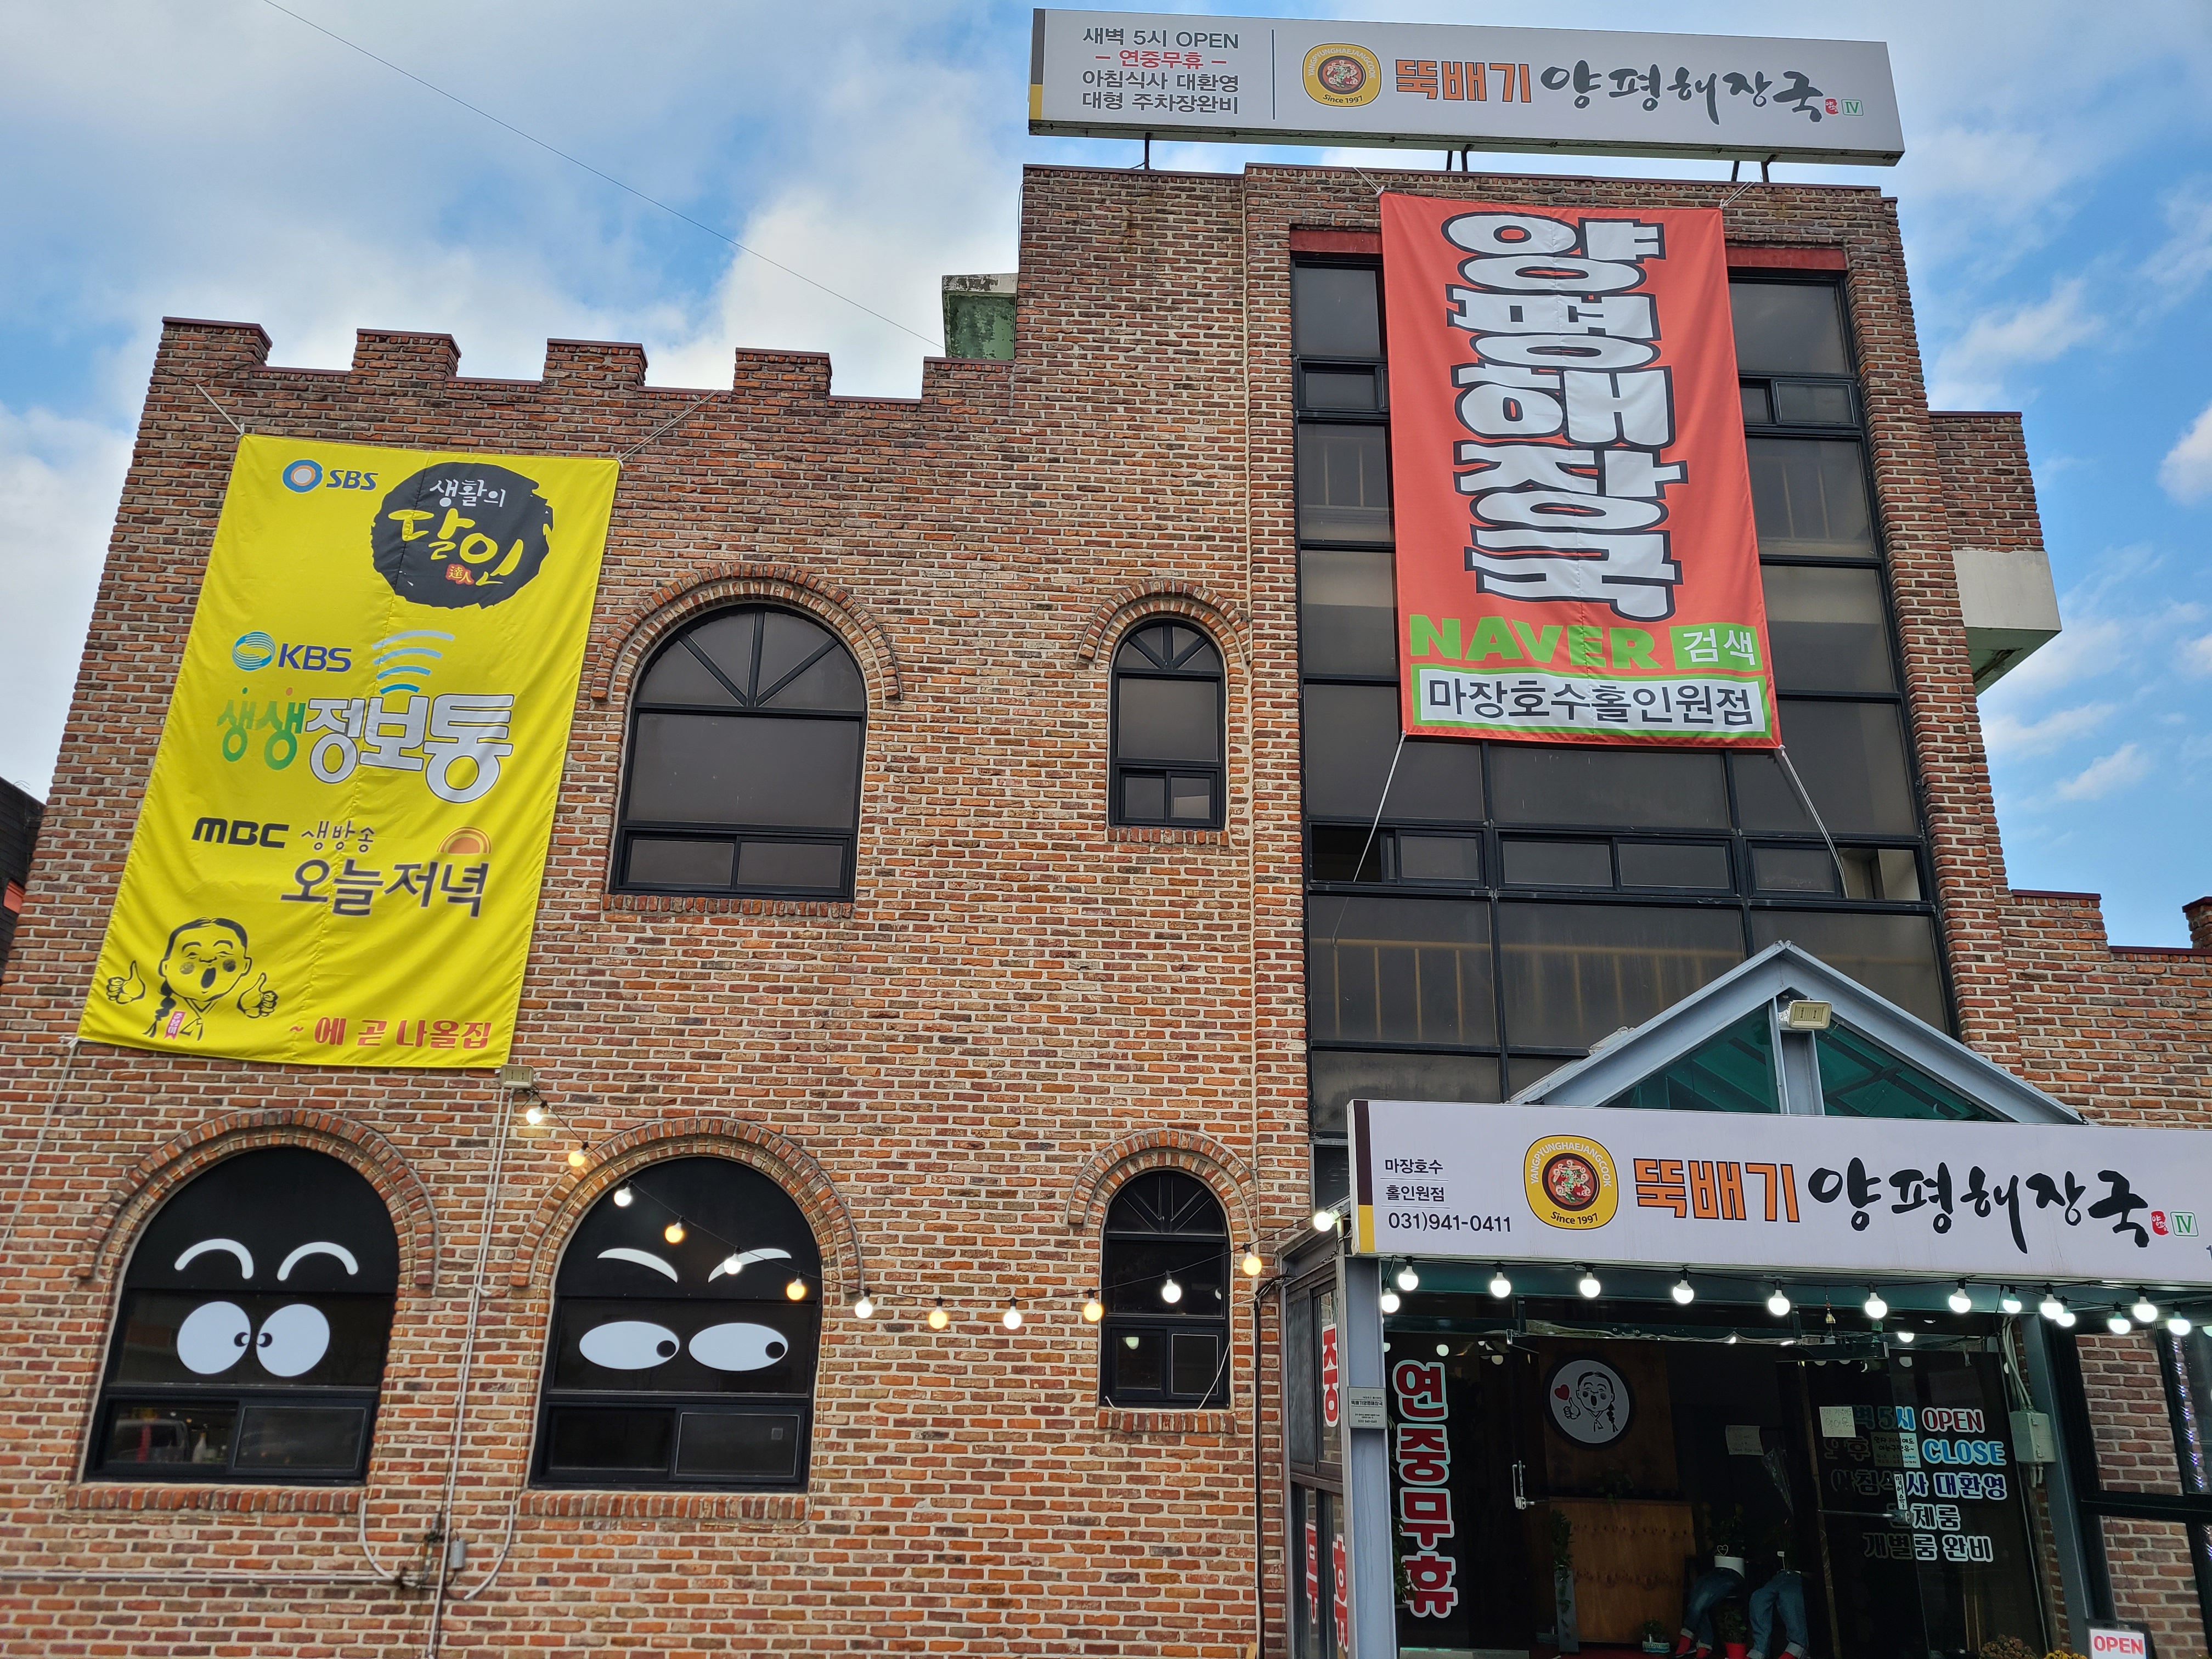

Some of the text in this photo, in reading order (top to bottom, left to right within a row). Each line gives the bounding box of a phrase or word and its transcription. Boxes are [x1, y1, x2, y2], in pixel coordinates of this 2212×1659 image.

[1082, 27, 1239, 49] 새벽 5시 OPEN
[1119, 50, 1204, 70] 연중무휴
[1308, 48, 1376, 78] YANGPYUNGHAEJANGCOOK
[1082, 70, 1239, 93] 아침식사 대환영
[1395, 59, 1824, 126] 뚝배기 양평해장국
[1082, 91, 1238, 115] 대형 주차장완비
[1322, 94, 1363, 104] Since 1997
[1441, 211, 1688, 622] 양평해장국
[326, 469, 380, 491] SBS
[430, 479, 506, 507] 생활의
[388, 508, 524, 586] 달인
[1410, 614, 1756, 669] NAVER 검색
[278, 643, 352, 672] KBS
[1429, 678, 1753, 726] 마장호수홀인원점
[191, 816, 290, 849] MBC
[301, 820, 375, 853] 생방송
[357, 1019, 387, 1047] 곧
[1385, 1158, 1443, 1175] 마장호수
[1530, 1142, 1612, 1188] YANGPYUNGHAEJANGCOOK
[1385, 1184, 1444, 1202] 홀인원점
[1633, 1156, 2149, 1254] 뚝배기 양평해장국
[1388, 1211, 1511, 1232] 031)941-0411
[1550, 1211, 1598, 1224] Since 1997
[1922, 1408, 1985, 1432] OPEN
[1922, 1438, 2007, 1465] CLOSE
[1392, 1359, 1458, 1618] 연중무휴
[1933, 1472, 2007, 1500] 대환영
[1942, 1534, 1994, 1562] 완비
[2094, 1635, 2144, 1655] OPEN
